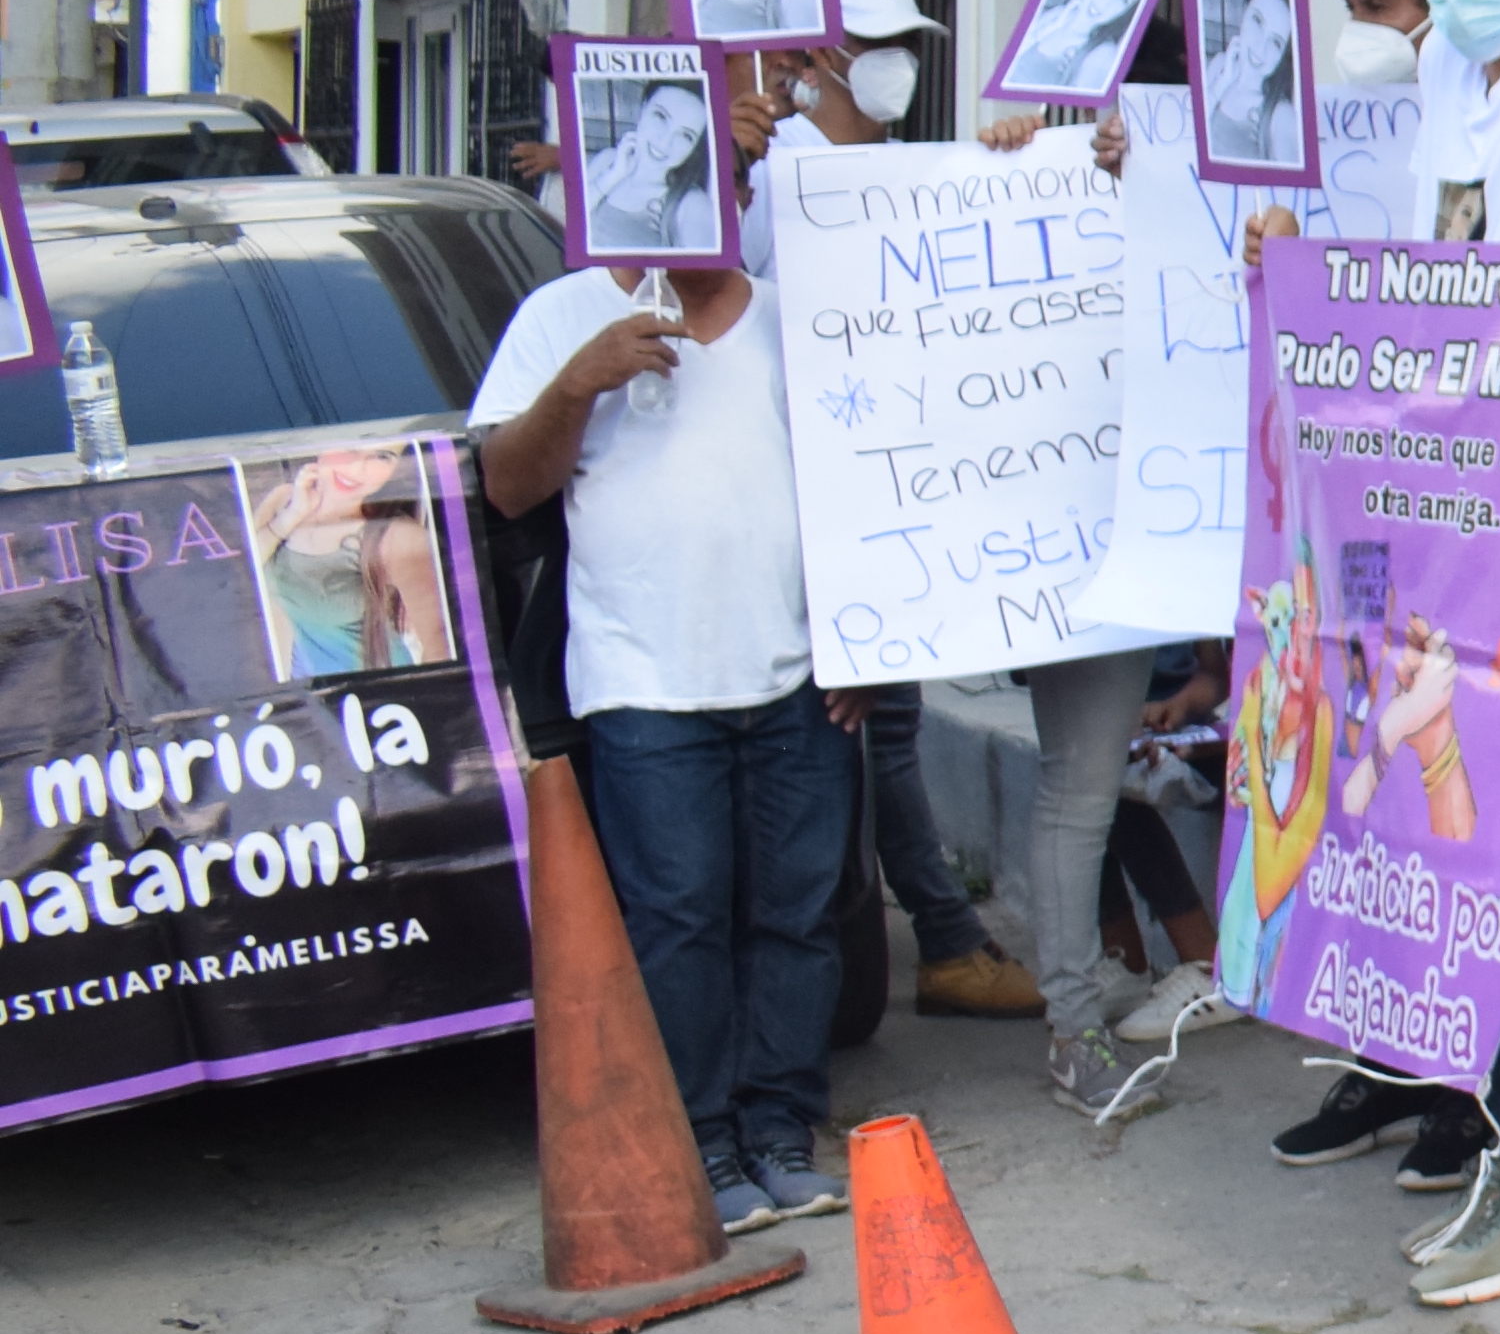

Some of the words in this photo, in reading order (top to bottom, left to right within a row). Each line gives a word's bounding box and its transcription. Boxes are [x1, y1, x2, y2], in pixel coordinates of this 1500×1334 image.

[579, 48, 699, 75] JUSTICIA
[796, 151, 897, 230] En
[910, 166, 1119, 220] memoria
[880, 207, 1124, 302] MELIS
[1323, 247, 1371, 301] Tu
[812, 306, 901, 357] que
[1158, 267, 1250, 363] LI
[957, 360, 1067, 408] aun
[1276, 331, 1362, 394] Pudo
[1369, 338, 1434, 395] Ser
[1437, 343, 1477, 397] El
[855, 423, 1121, 507] Tenemo
[1297, 417, 1335, 459] Hoy
[1341, 429, 1385, 458] nos
[1390, 427, 1445, 465] toca
[1451, 438, 1496, 475] que
[1138, 445, 1248, 536] SI
[1363, 482, 1411, 521] otra
[860, 505, 1113, 602] Justic
[998, 576, 1104, 648] ME
[30, 703, 323, 829] murió,
[341, 692, 430, 773] la
[1308, 830, 1442, 941] Justicia
[1304, 941, 1480, 1071] Alejandra
